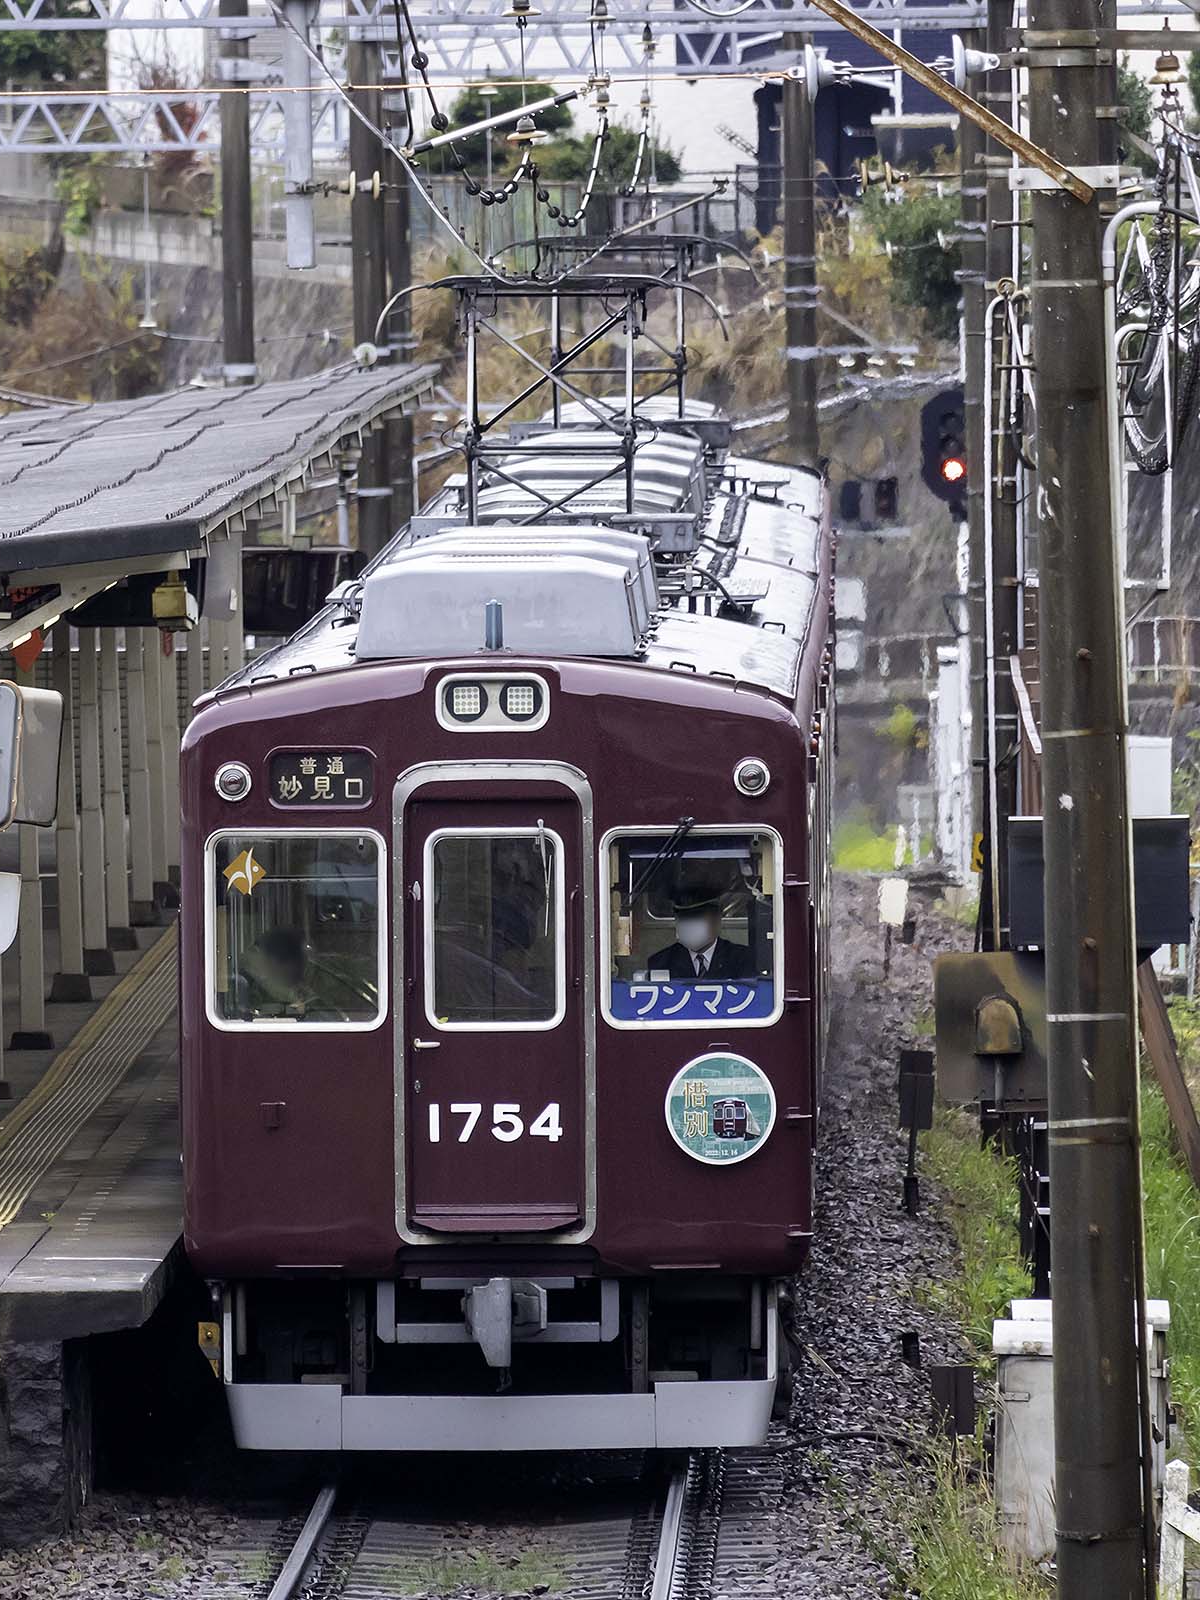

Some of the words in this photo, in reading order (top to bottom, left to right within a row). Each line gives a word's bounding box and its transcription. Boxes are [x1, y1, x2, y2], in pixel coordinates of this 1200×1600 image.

[299, 757, 345, 775] 普通
[278, 775, 363, 800] 妙見口
[630, 985, 756, 1015] ワンマン
[429, 1102, 563, 1143] 1754
[682, 1081, 709, 1138] 惜別
